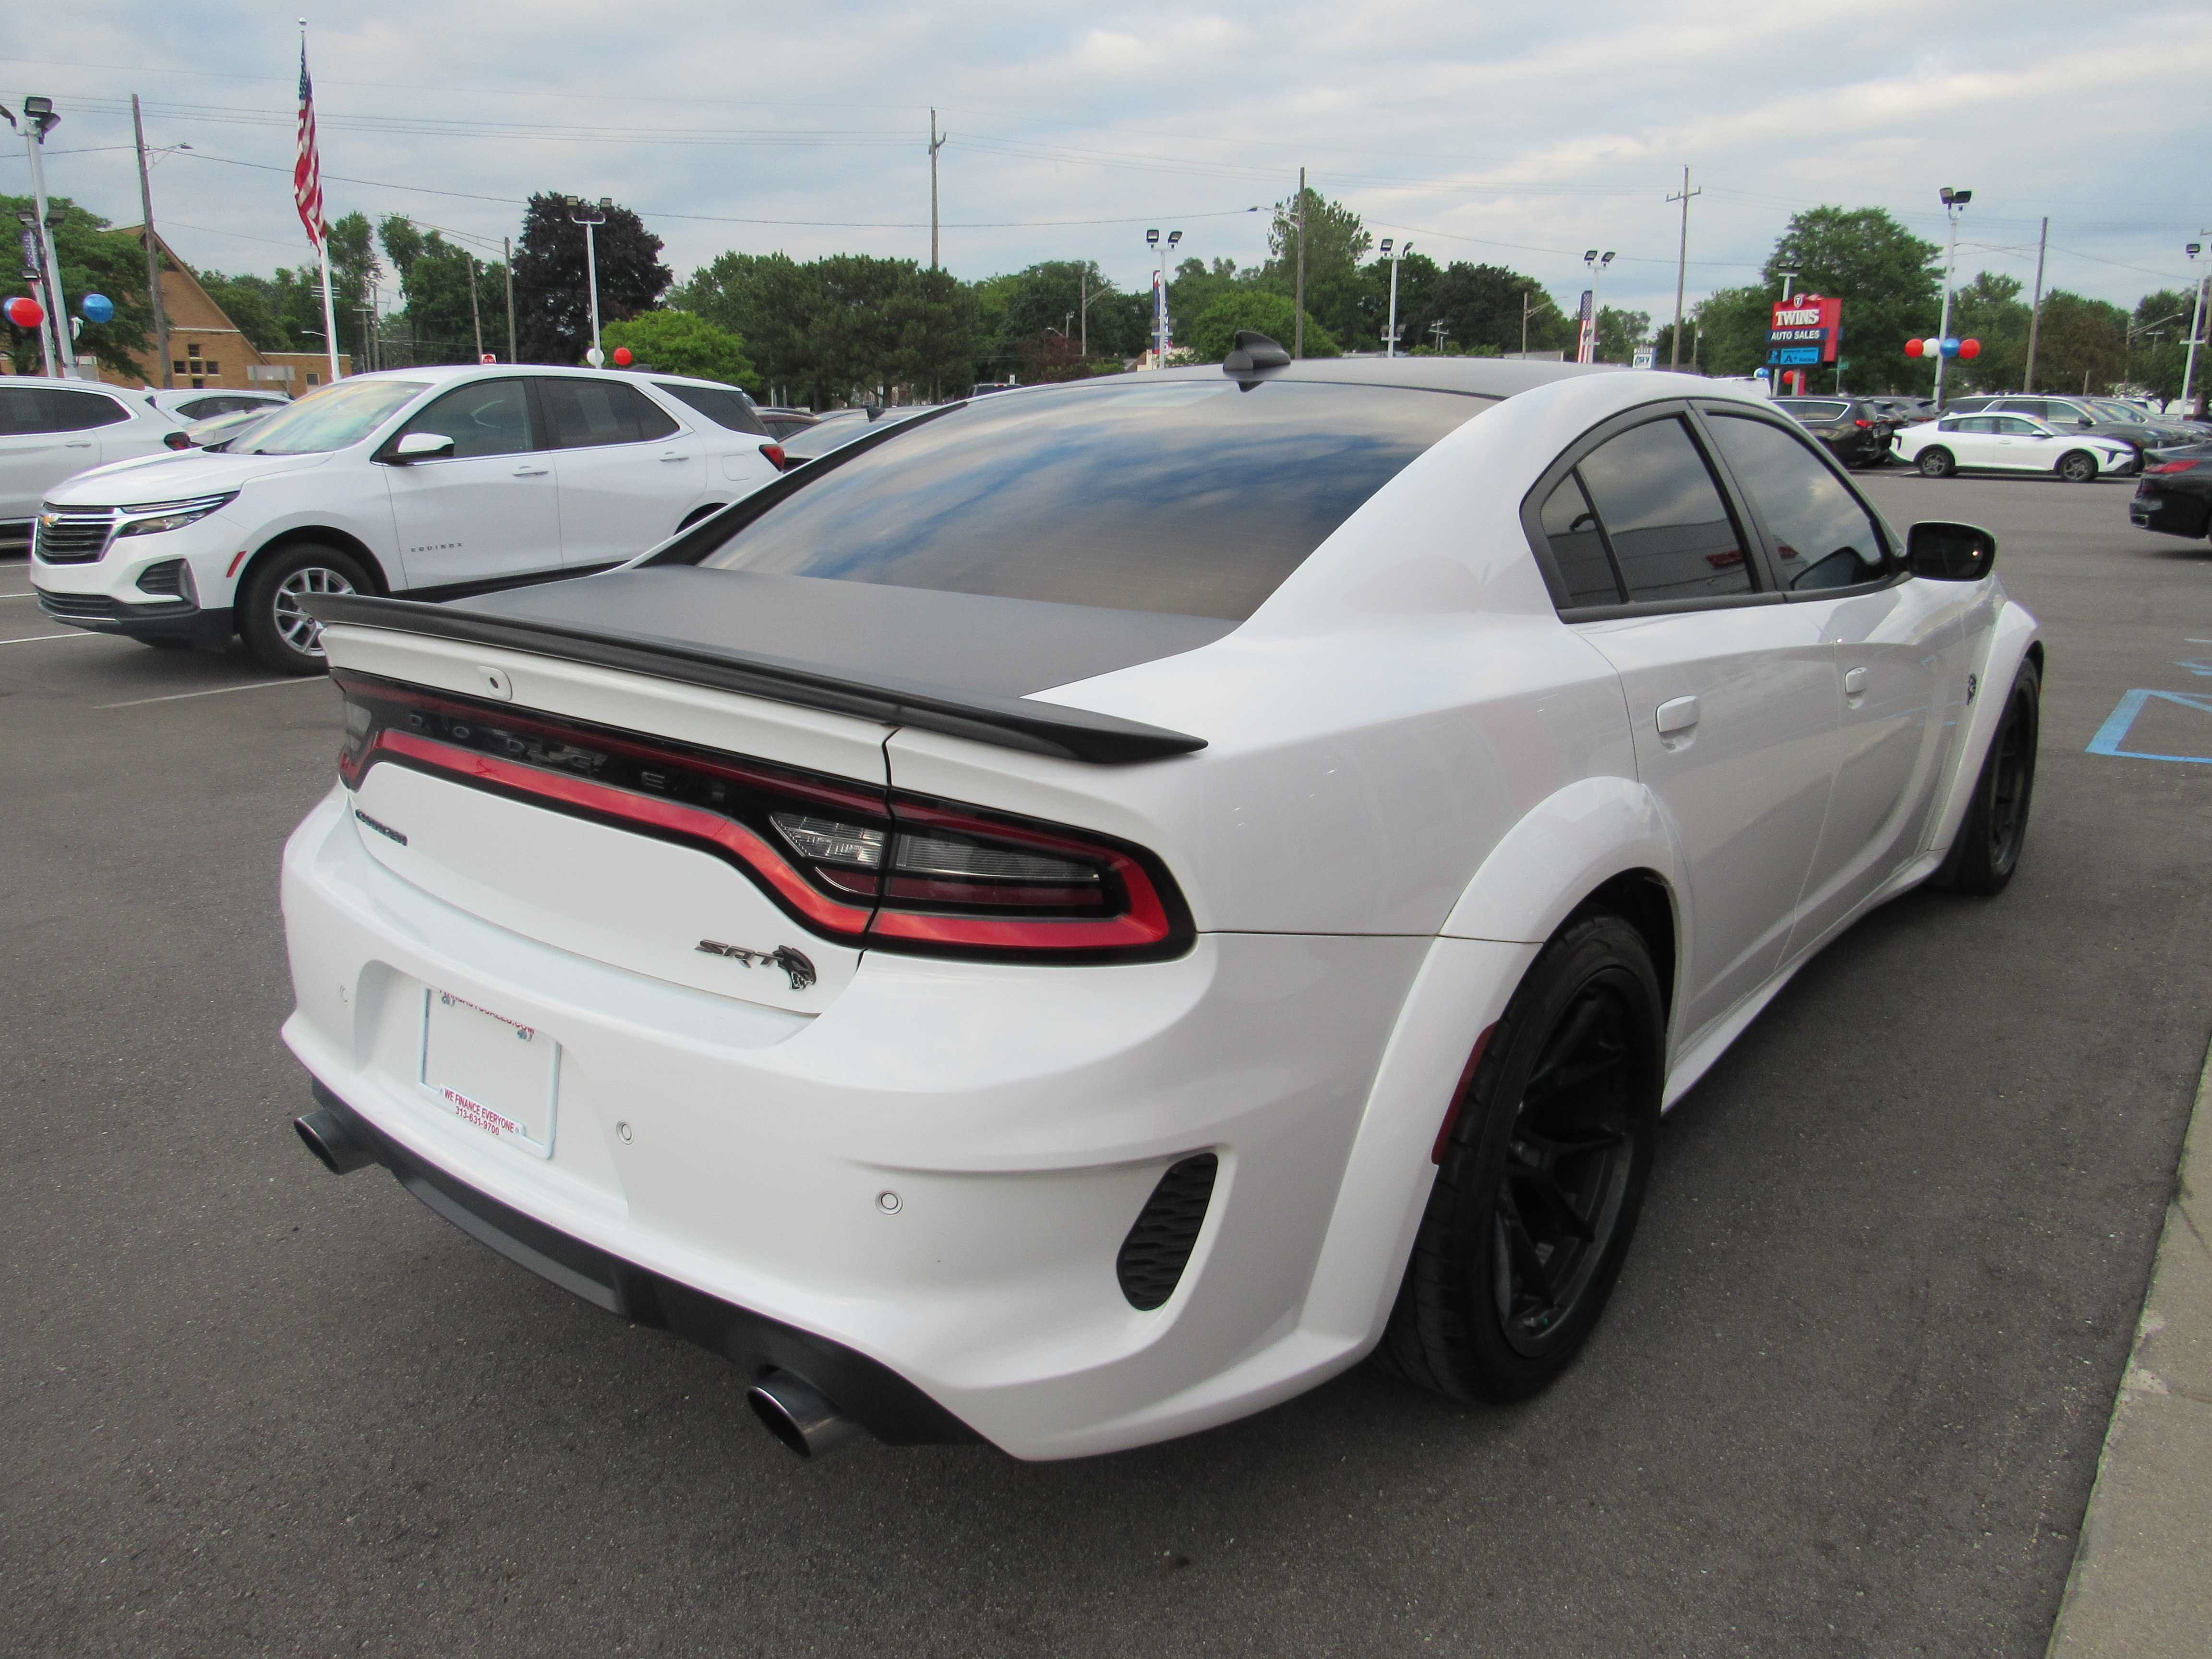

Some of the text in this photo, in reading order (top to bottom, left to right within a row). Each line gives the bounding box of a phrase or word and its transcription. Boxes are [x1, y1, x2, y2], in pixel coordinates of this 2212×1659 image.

[1775, 309, 1820, 326] TWINS
[1770, 330, 1820, 341] AUTO SALES
[410, 542, 463, 552] EQUINOX
[695, 939, 784, 968] SRT
[445, 1088, 515, 1133] WE FINANCE EVERYONE
[456, 1106, 500, 1135] 313-631-9700
